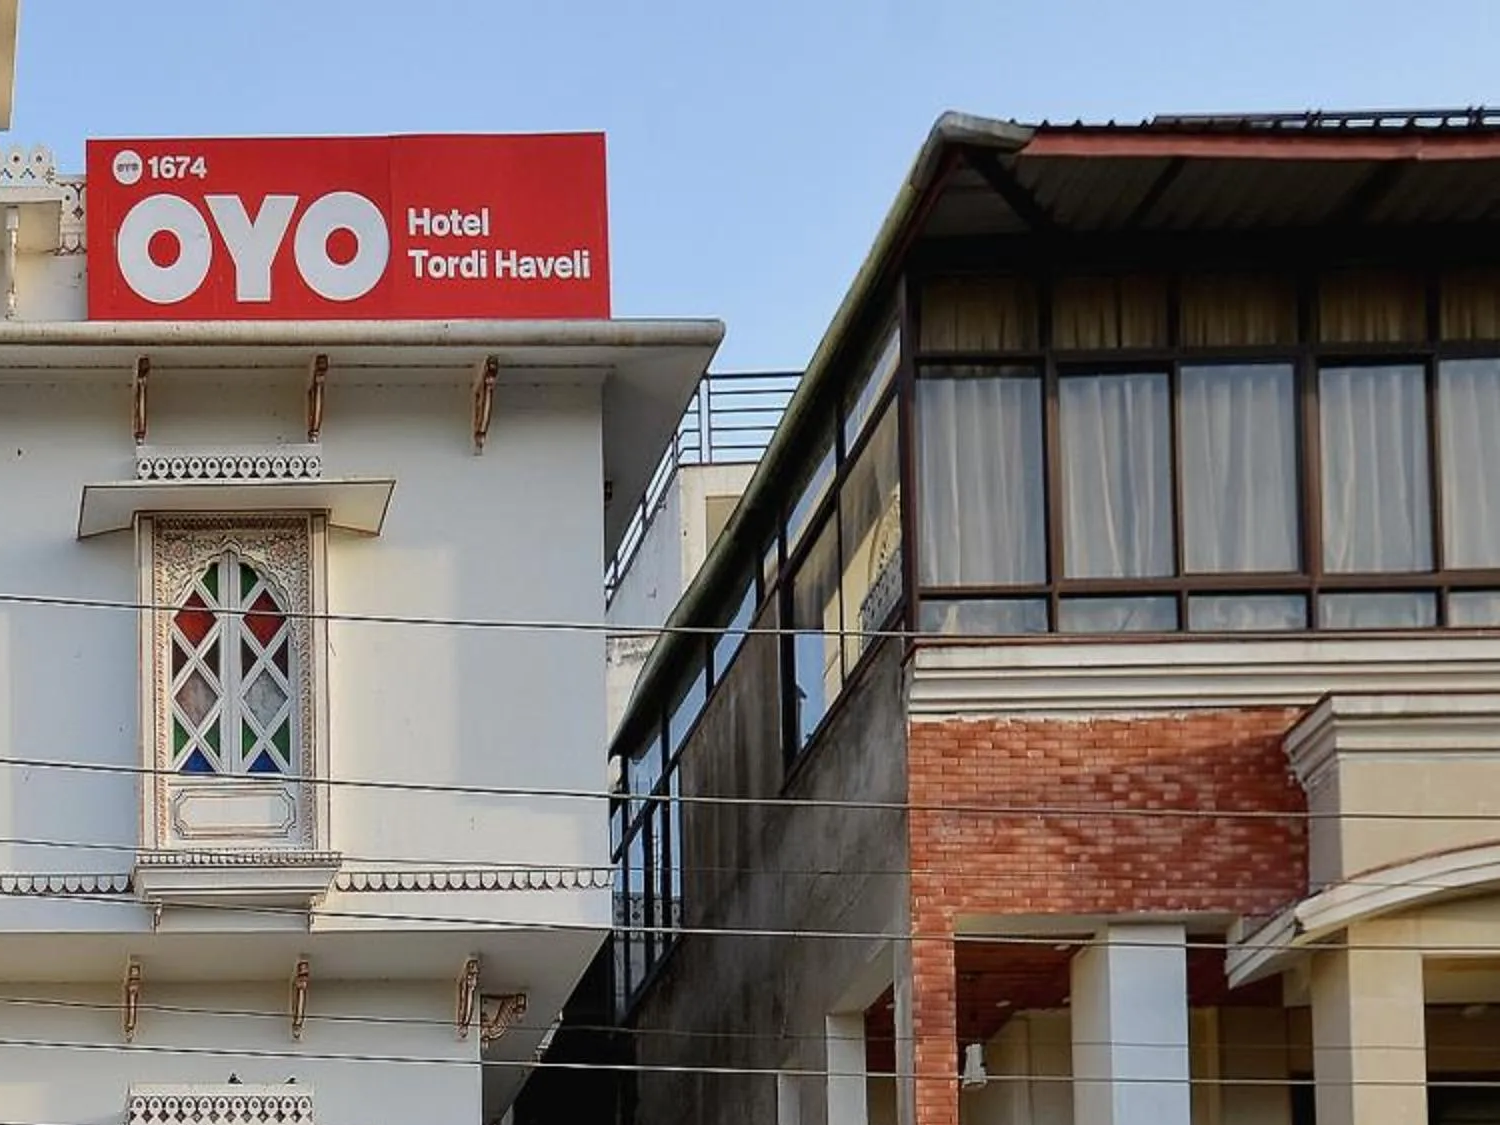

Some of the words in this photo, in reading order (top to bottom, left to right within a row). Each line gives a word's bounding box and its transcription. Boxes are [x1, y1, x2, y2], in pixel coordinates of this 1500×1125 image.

[147, 155, 208, 179] 1674
[407, 207, 490, 237] Hotel
[117, 191, 391, 304] OYO
[407, 249, 488, 279] Tordi
[495, 249, 591, 279] Haveli
